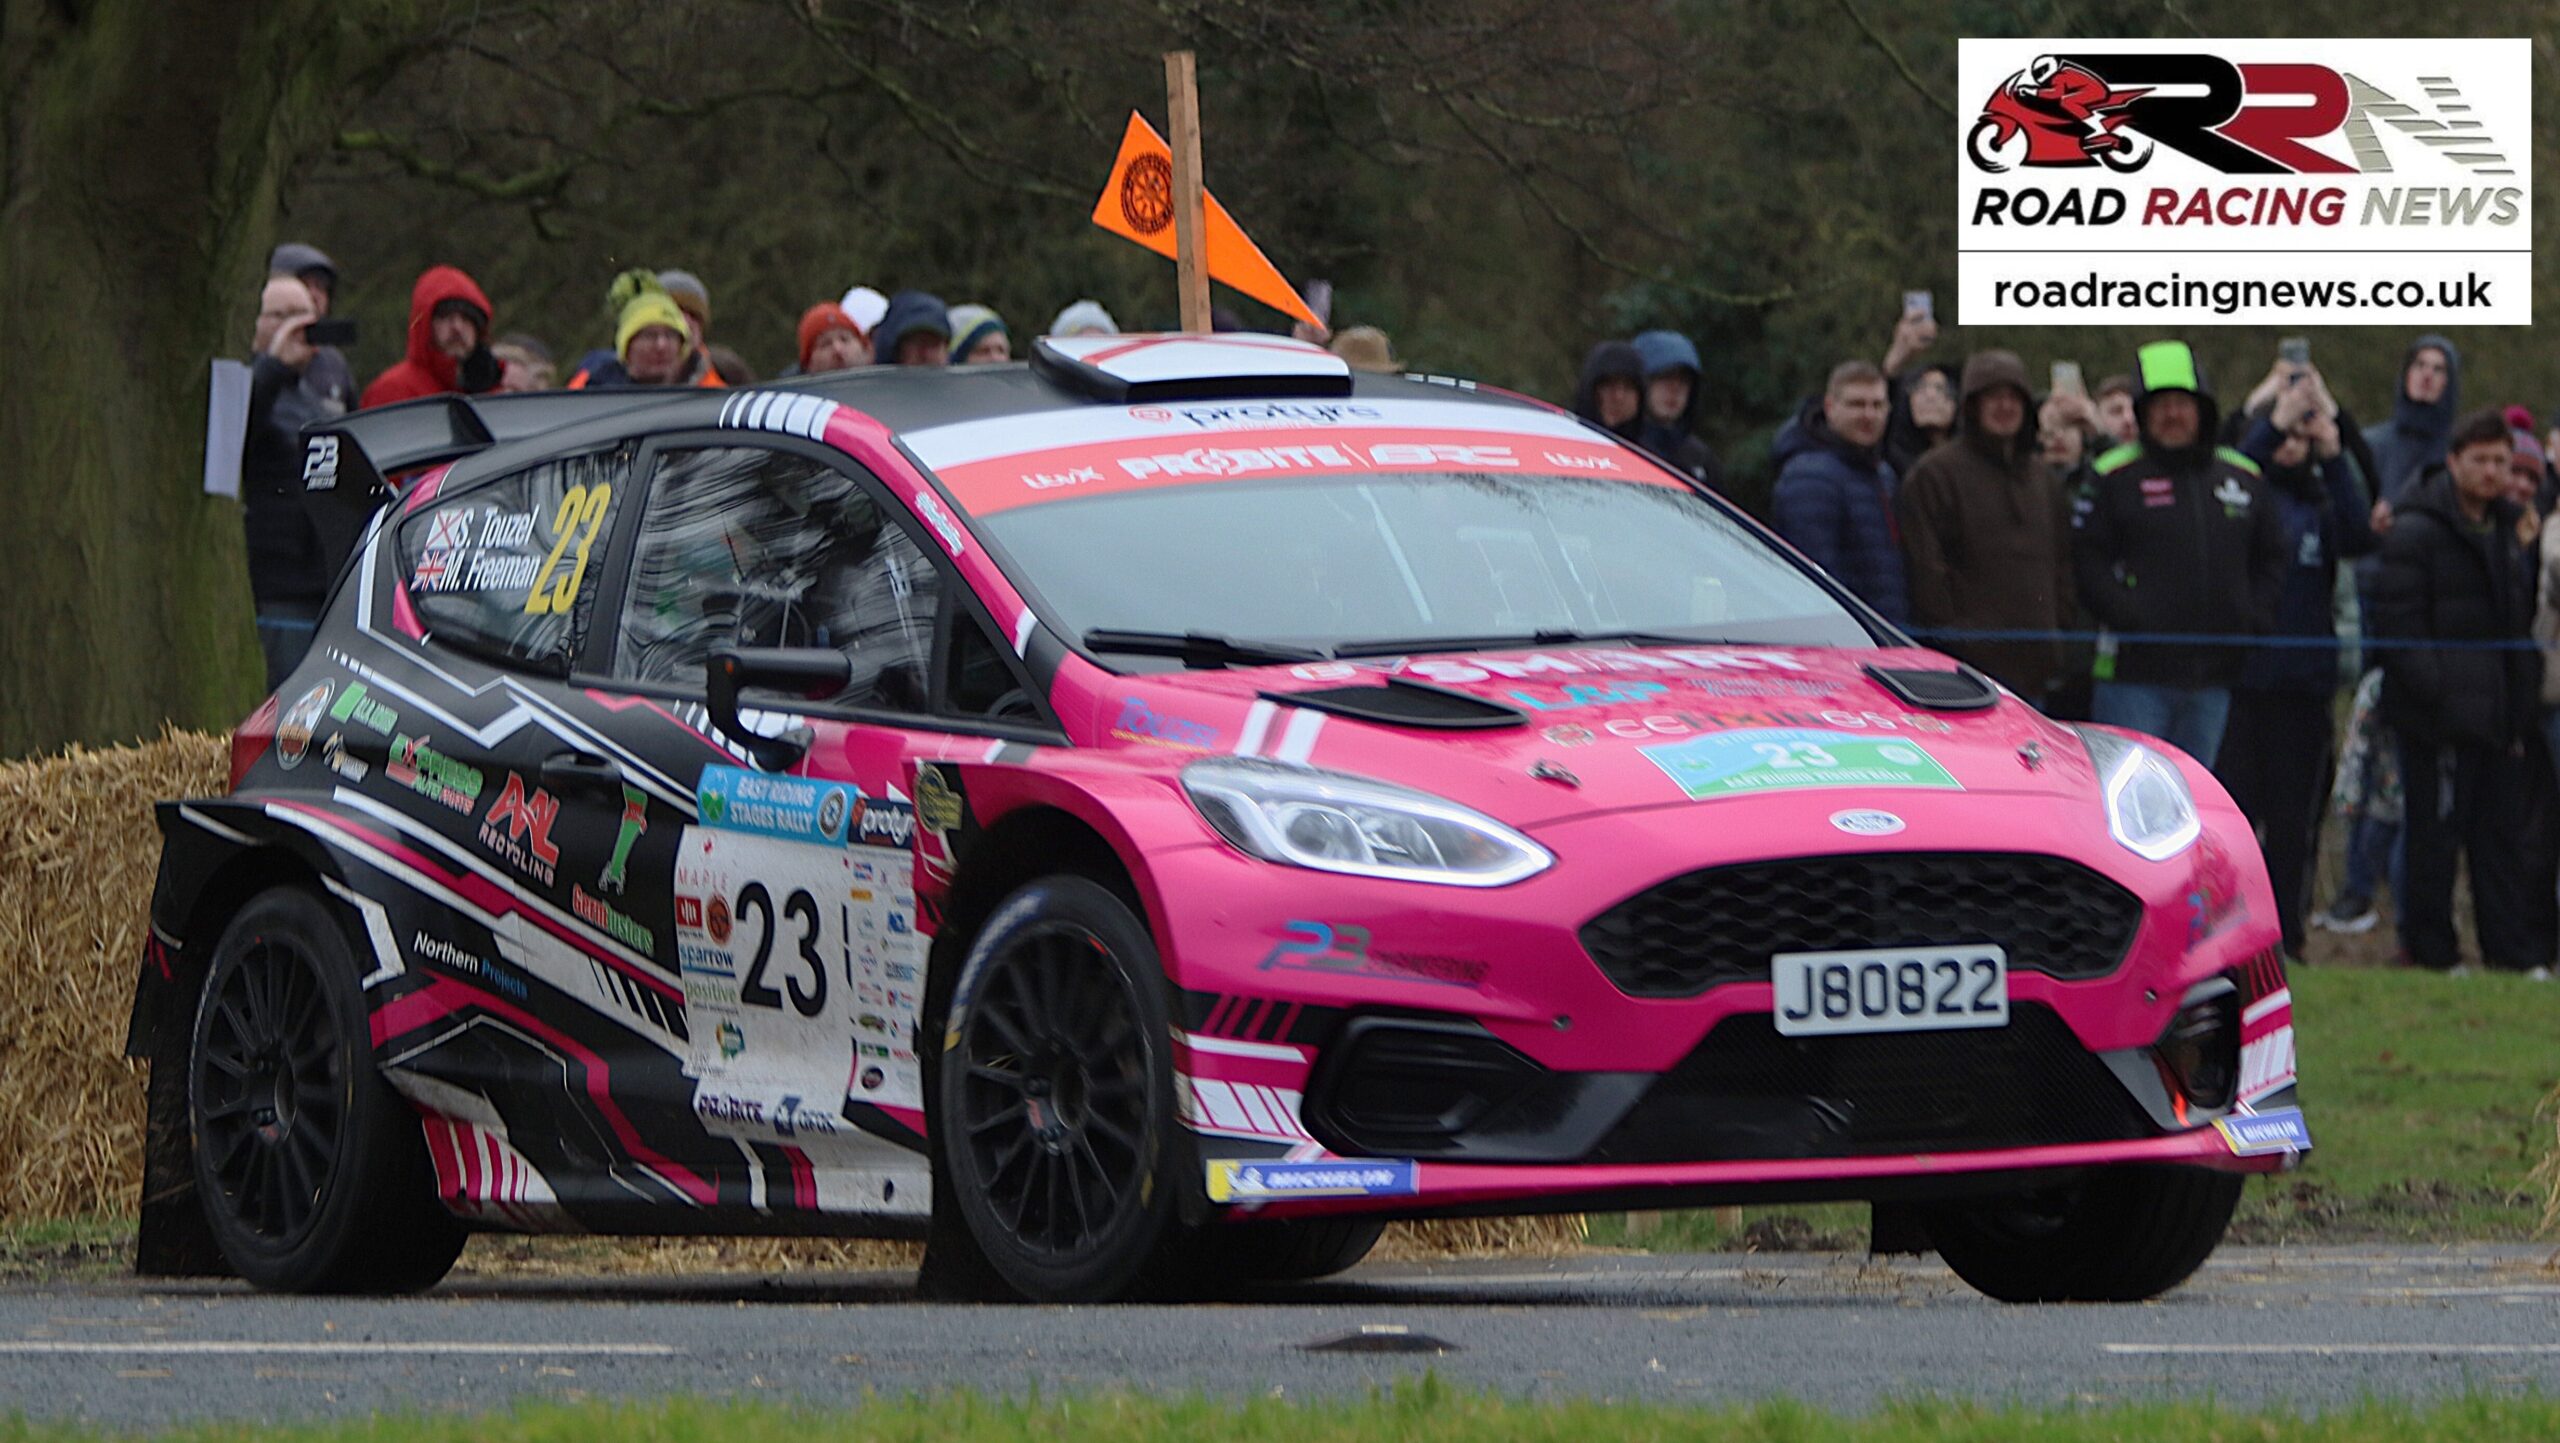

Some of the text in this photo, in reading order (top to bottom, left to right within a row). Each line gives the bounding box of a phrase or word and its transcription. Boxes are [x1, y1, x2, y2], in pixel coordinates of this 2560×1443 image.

[452, 503, 541, 549] S. Touzel
[524, 483, 612, 615] 23
[439, 550, 541, 592] M. Freeman
[1752, 741, 1840, 770] 23
[737, 776, 816, 808] EAST RIDING
[730, 802, 815, 834] STAGES RALLY
[478, 822, 554, 888] RECYCLING
[413, 930, 479, 975] Northern
[679, 945, 734, 969] sparrow
[736, 882, 827, 1018] 23
[684, 977, 737, 1004] positive
[1784, 957, 2001, 1021] J80822
